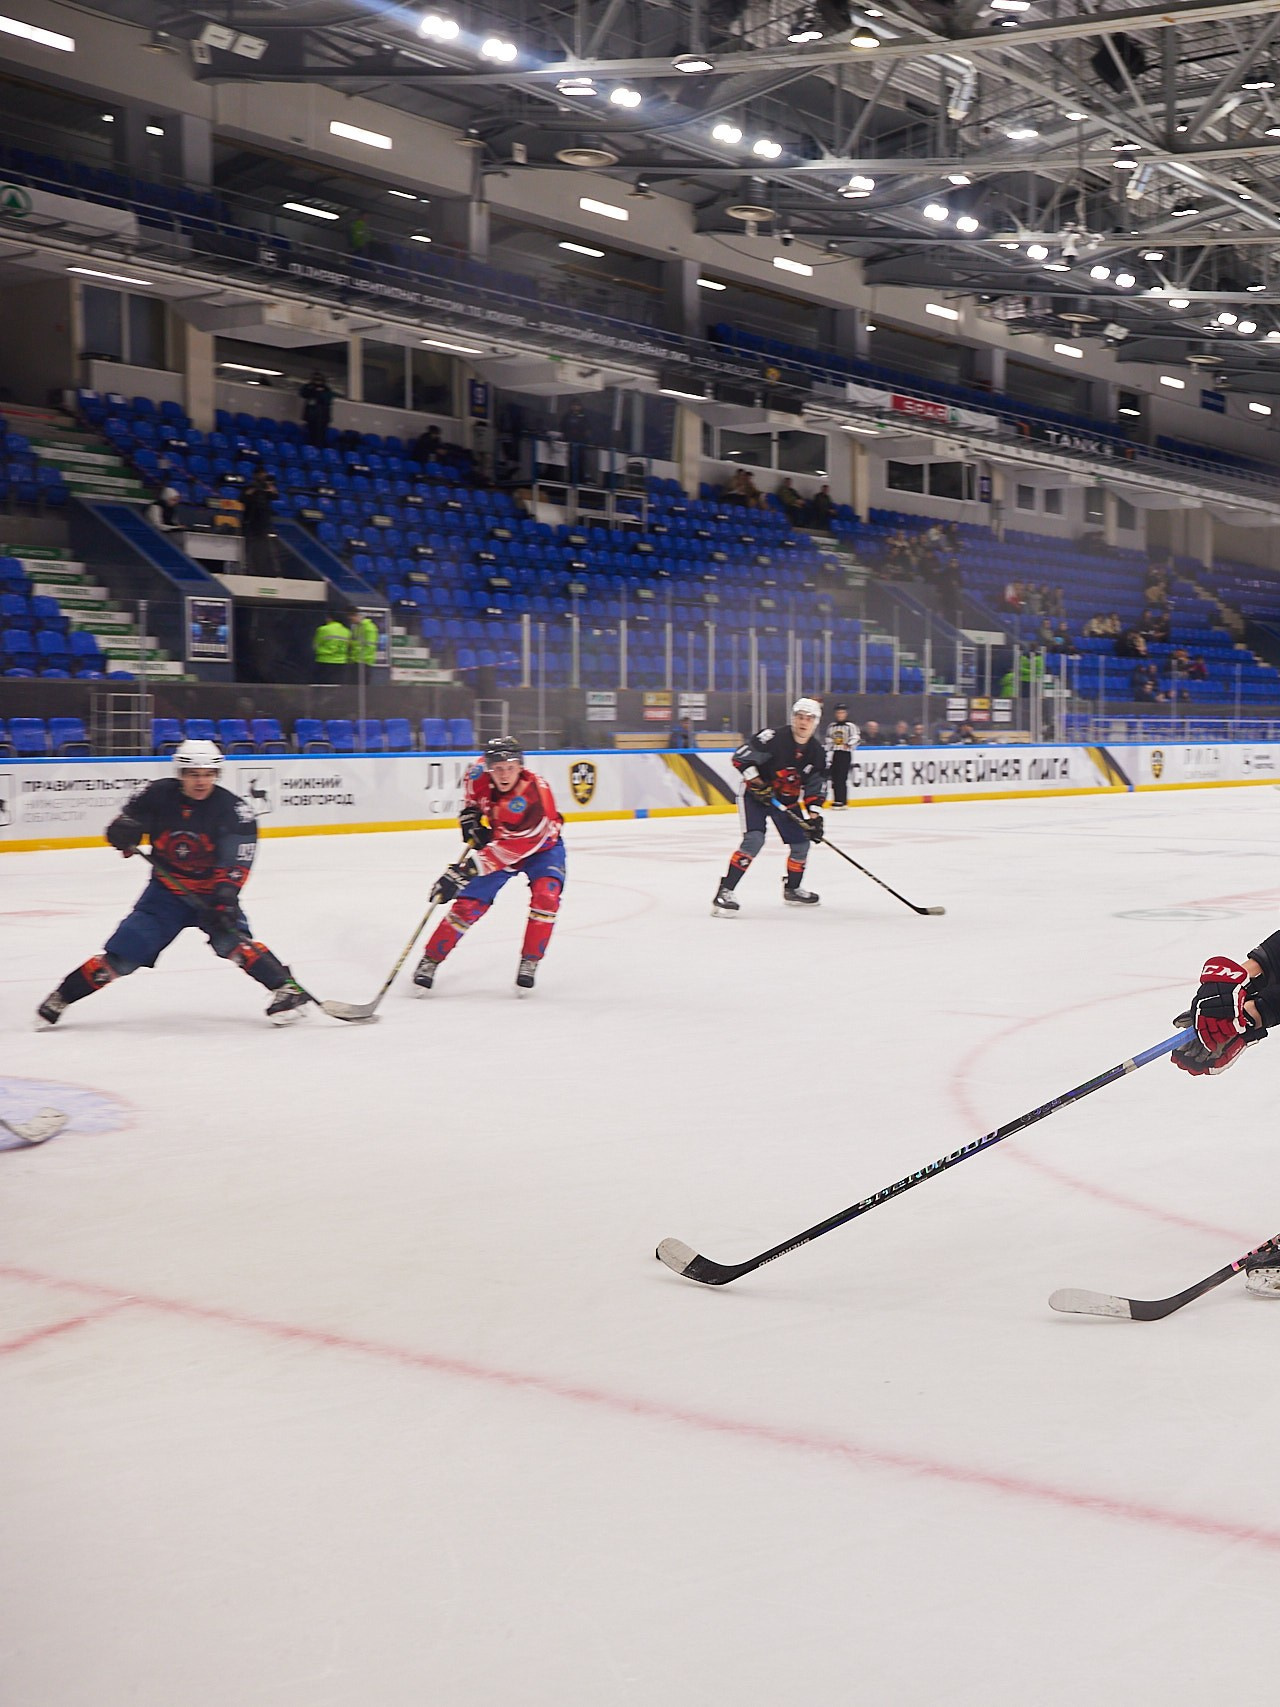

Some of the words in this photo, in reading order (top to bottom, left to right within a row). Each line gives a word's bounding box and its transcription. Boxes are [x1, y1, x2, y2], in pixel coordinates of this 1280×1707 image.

[903, 400, 947, 420] SPAR
[912, 753, 1022, 785] ХОККЕЙНАЯ
[1028, 757, 1069, 780] ЛИГА
[280, 774, 343, 790] НИЖНИЙ
[280, 793, 355, 807] НОВГОРОД
